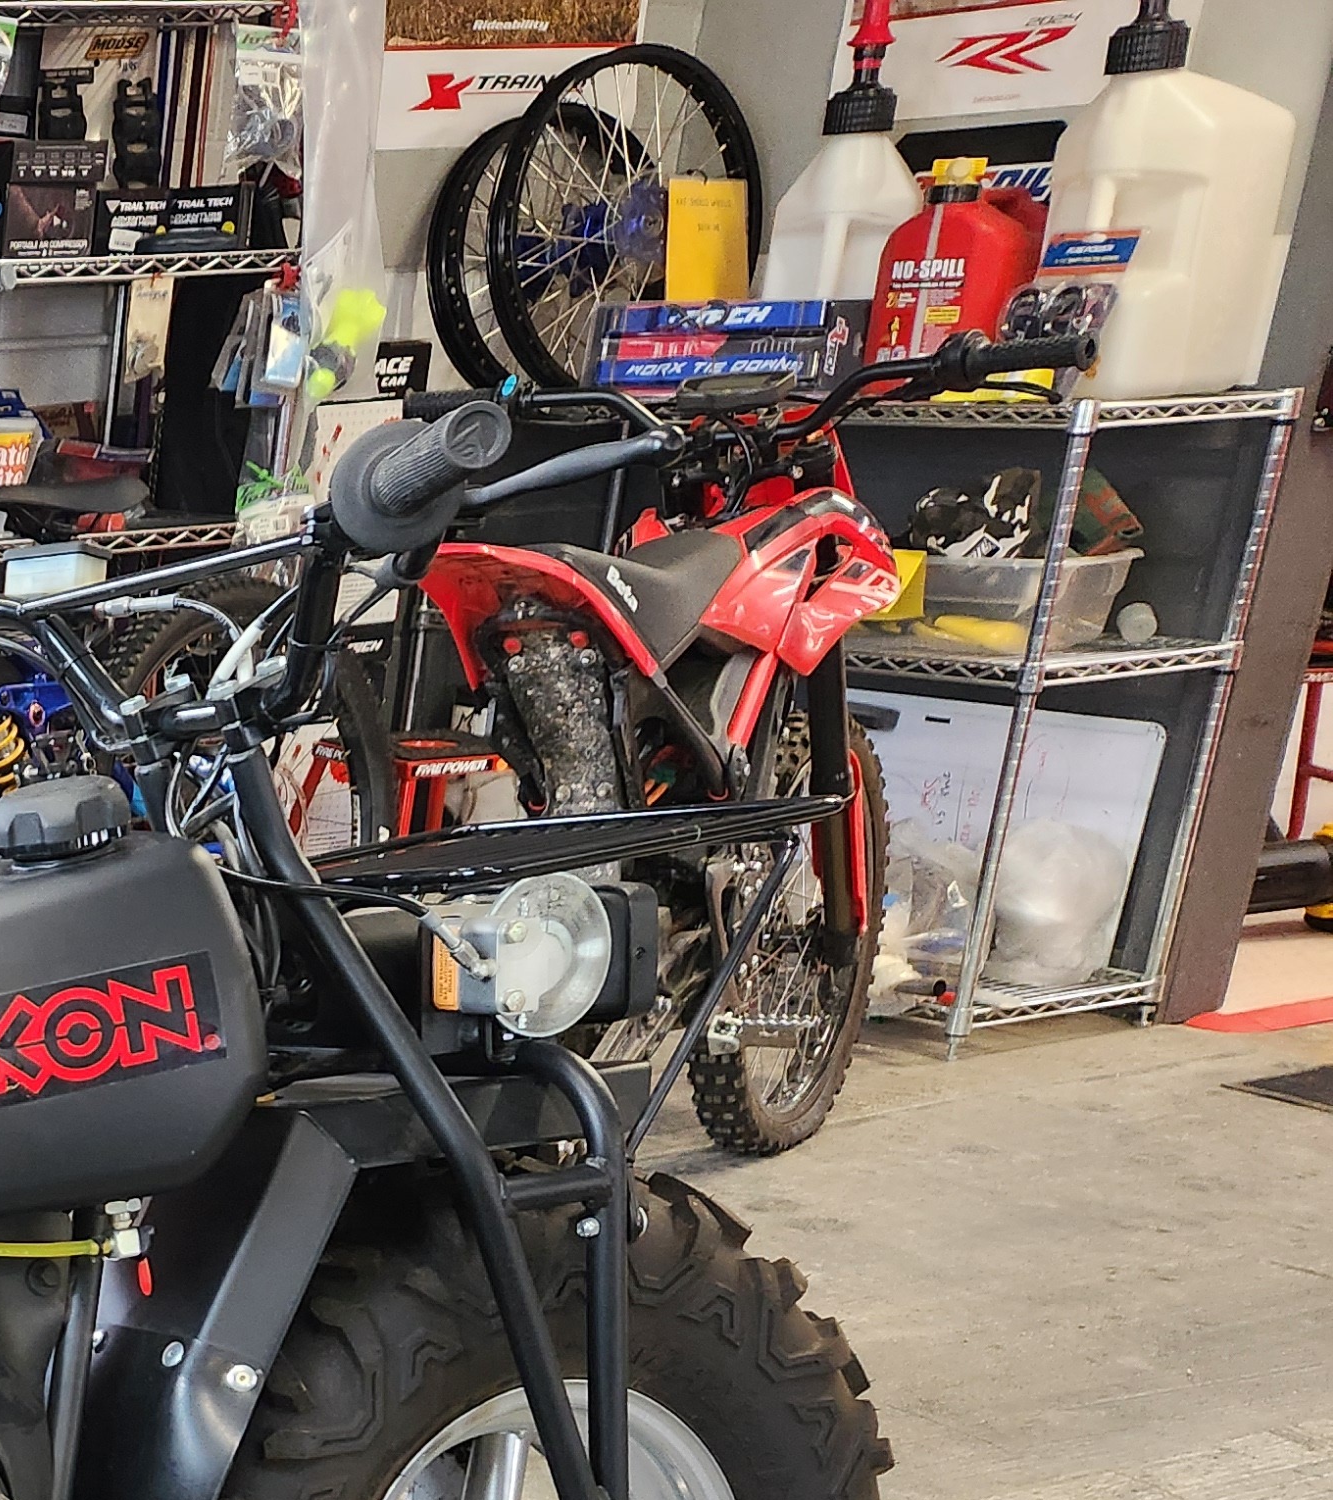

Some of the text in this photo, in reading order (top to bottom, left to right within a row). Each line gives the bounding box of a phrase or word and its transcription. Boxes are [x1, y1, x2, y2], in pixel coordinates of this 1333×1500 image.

[471, 18, 550, 33] Rideability
[1024, 10, 1084, 28] 2024
[93, 33, 145, 51] MOOSE
[478, 73, 558, 92] TRAIN
[119, 200, 167, 212] TRAIL TECH
[176, 197, 234, 209] TRAIL TECH
[374, 355, 415, 376] ACE
[380, 375, 408, 388] CAN
[605, 564, 639, 613] Beta
